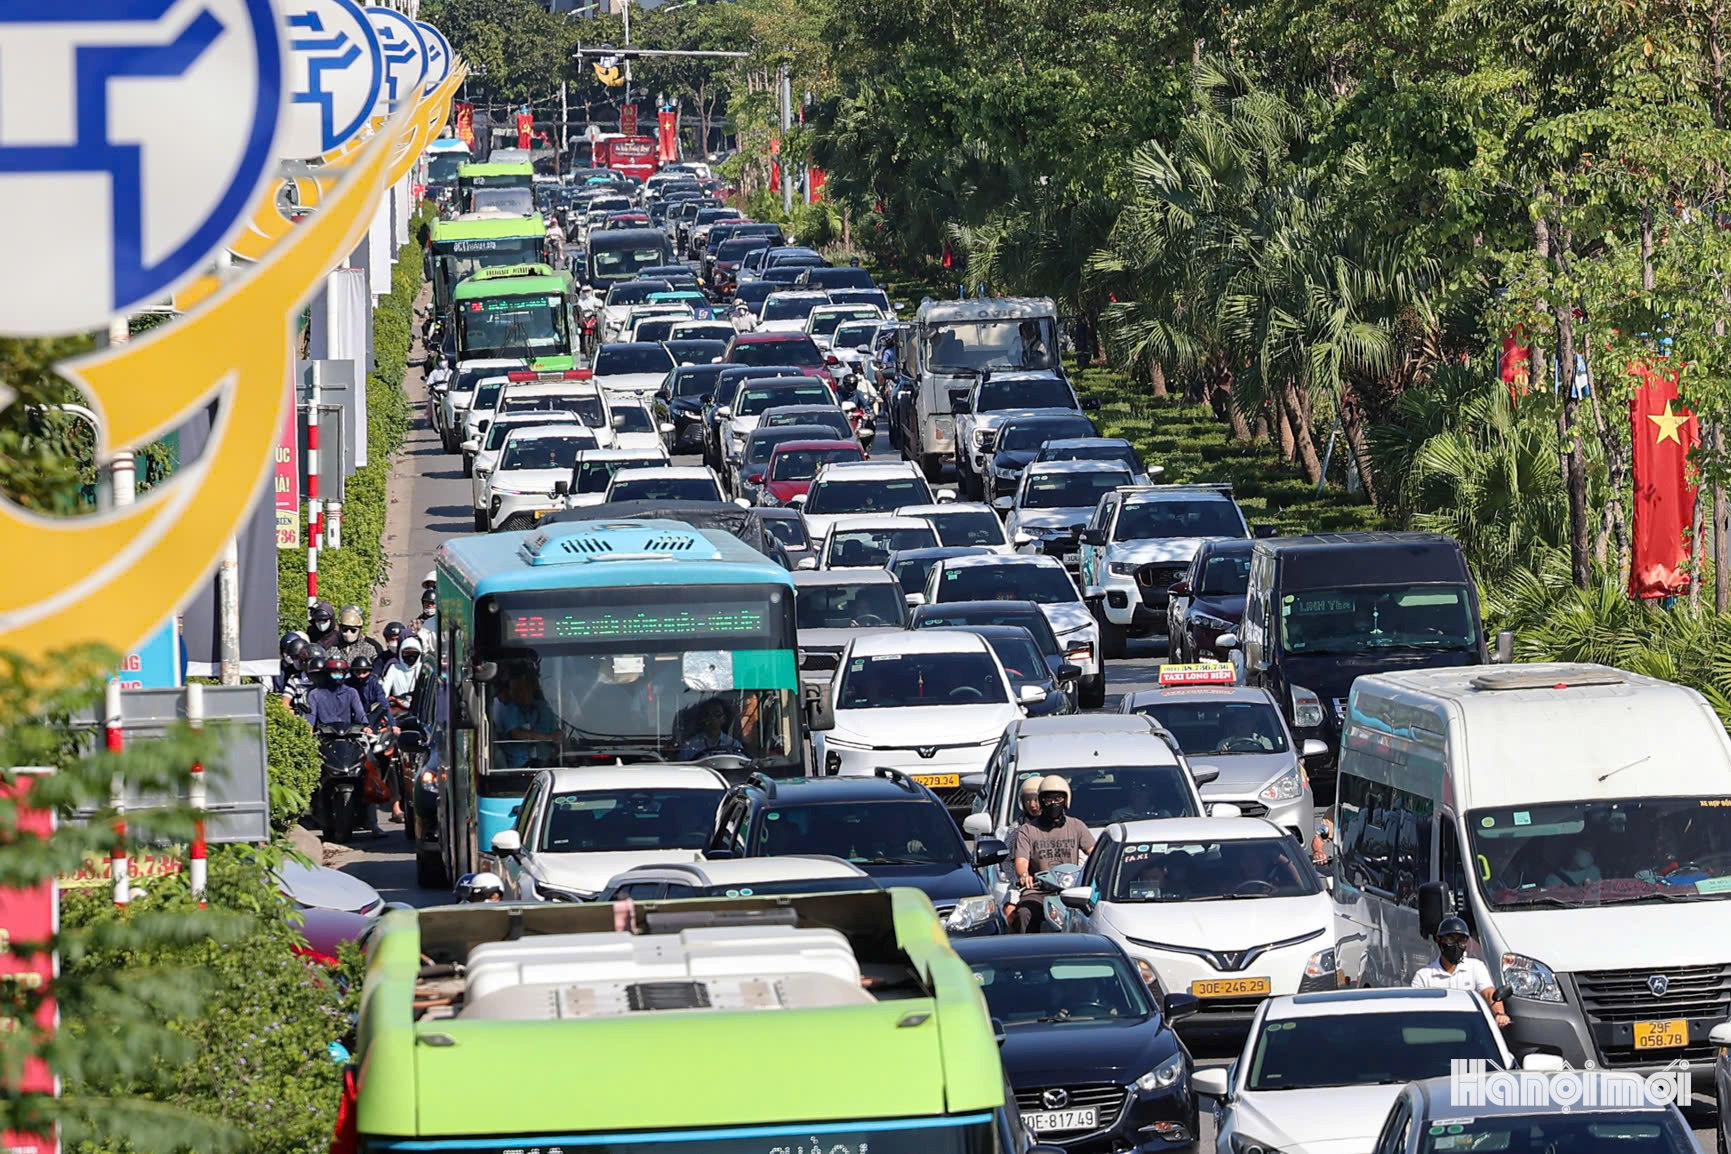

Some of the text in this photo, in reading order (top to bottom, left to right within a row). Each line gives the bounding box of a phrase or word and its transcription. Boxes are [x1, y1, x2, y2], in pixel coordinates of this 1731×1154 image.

[1163, 673, 1185, 681] TAXI
[1186, 672, 1209, 680] LONG
[1199, 980, 1264, 994] 30E-246.29
[1649, 1022, 1672, 1034] 29F
[1640, 1034, 1682, 1047] 058.78
